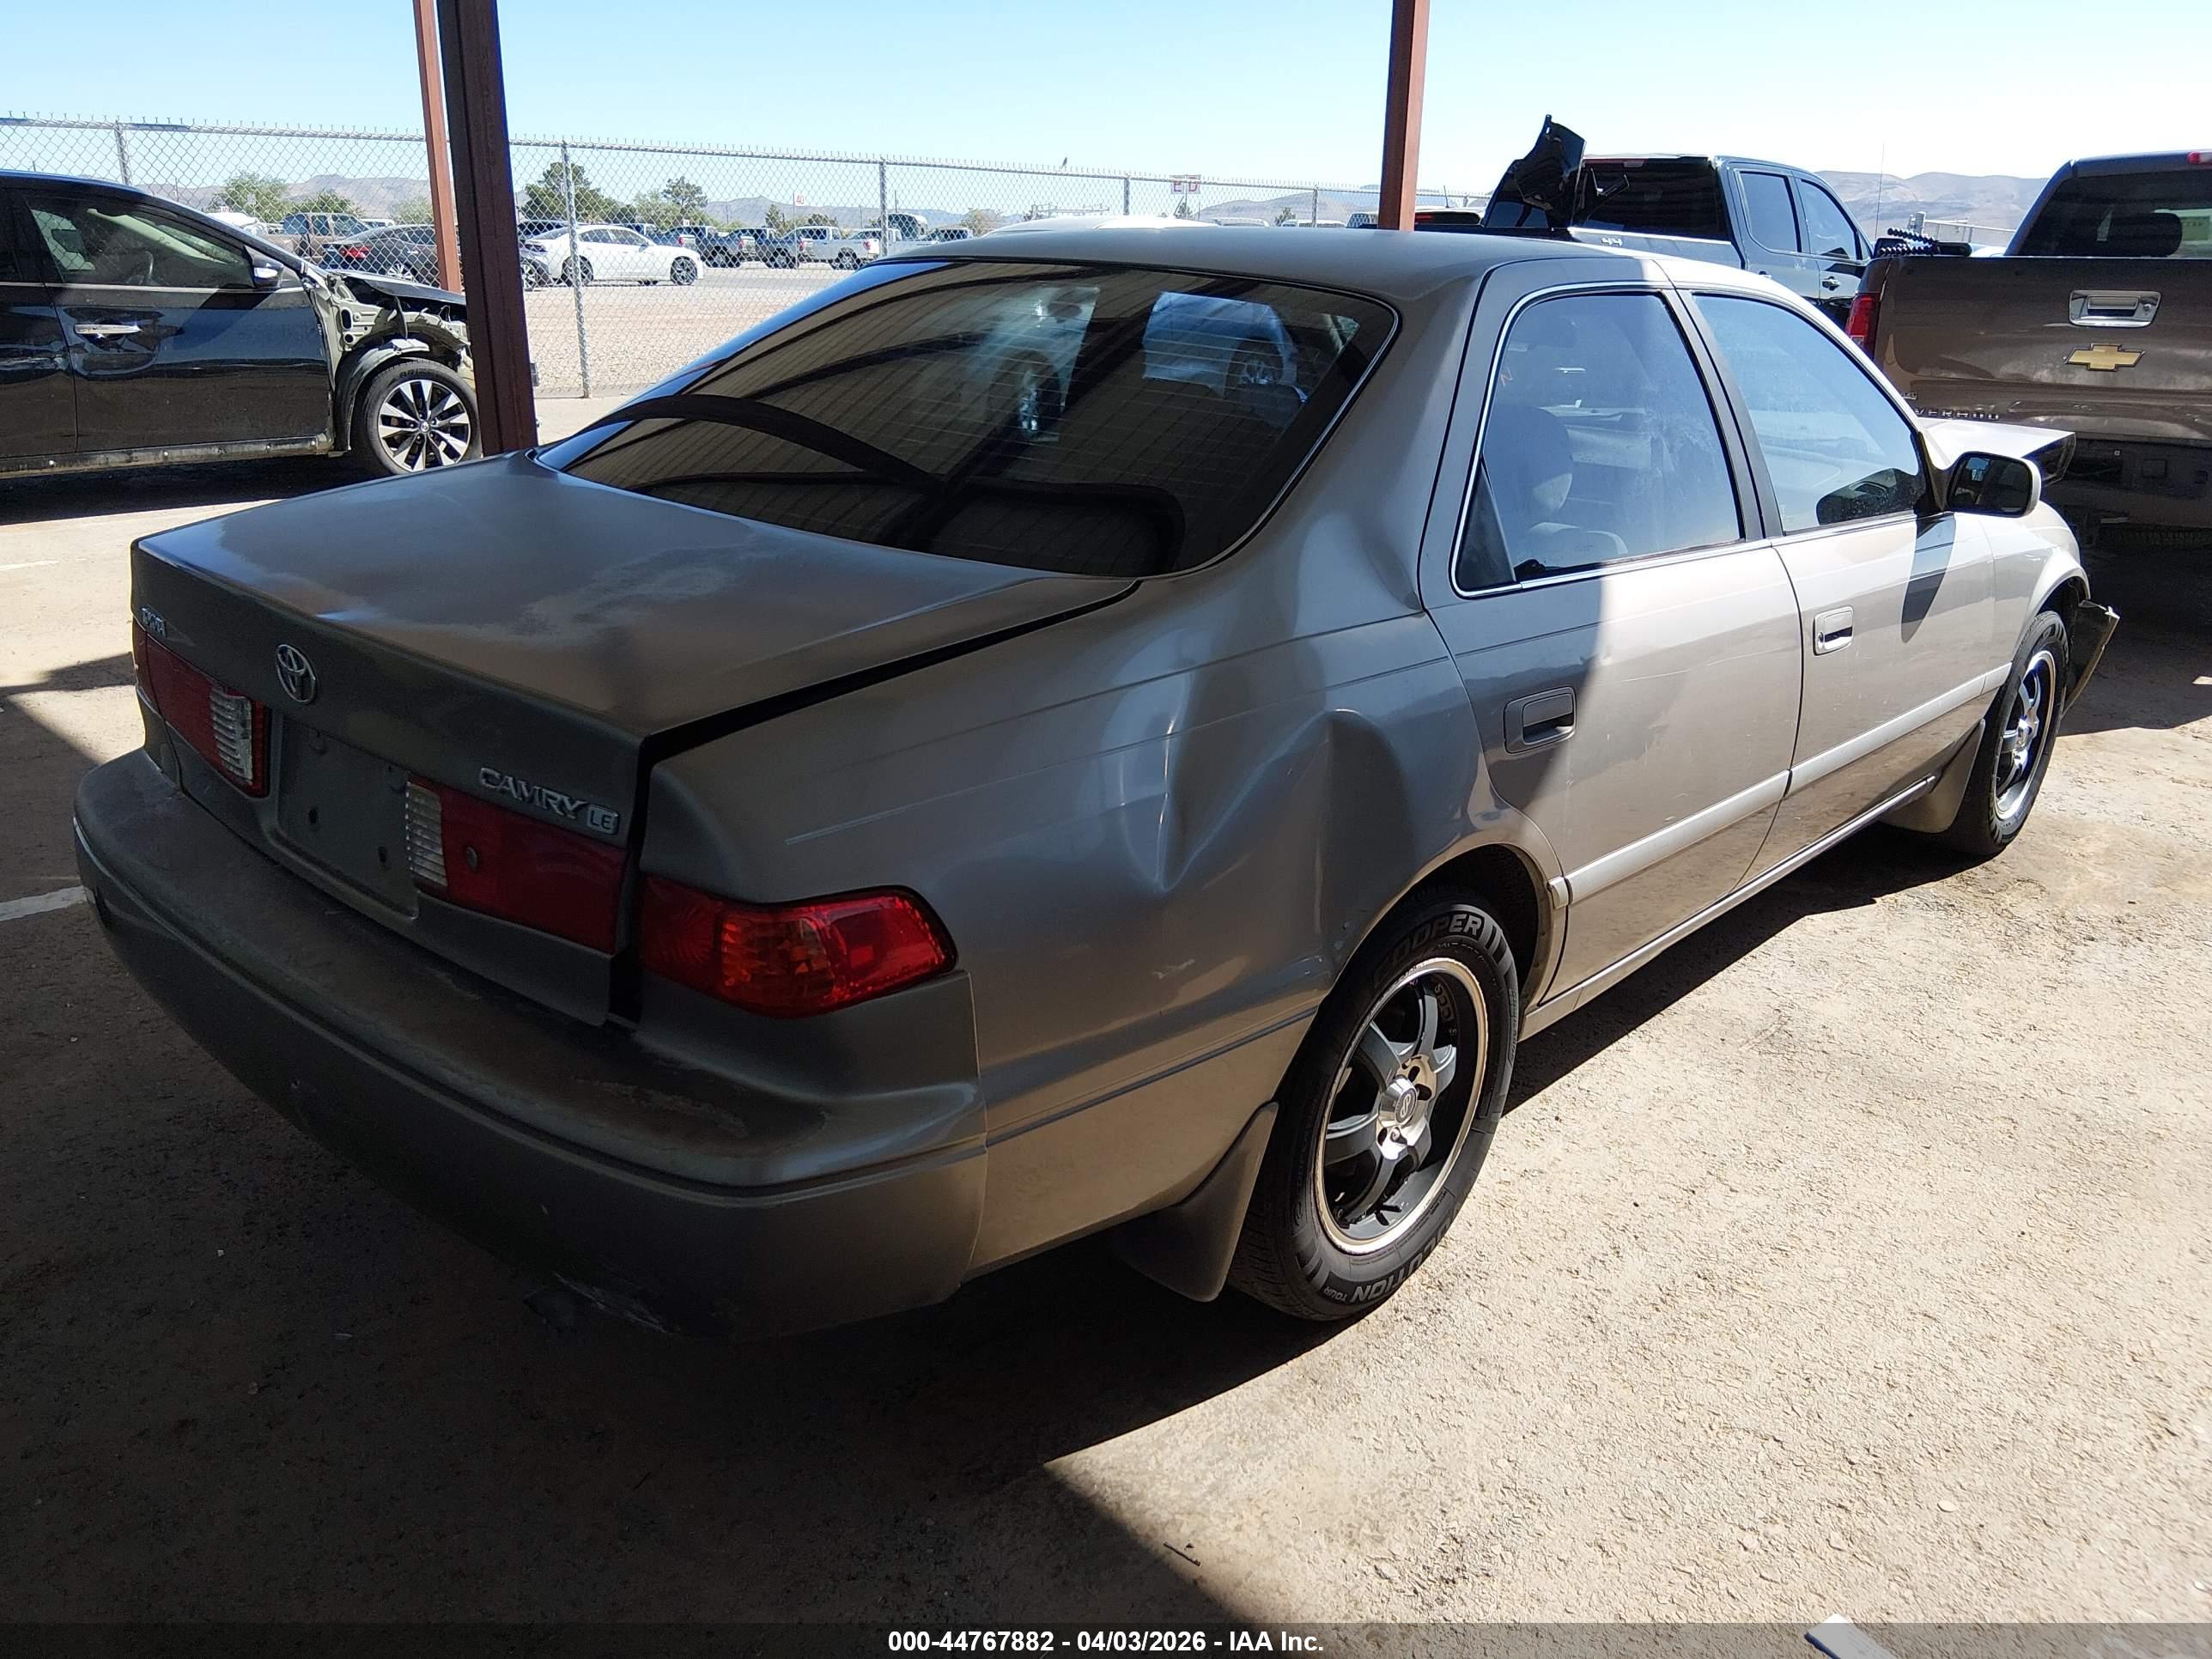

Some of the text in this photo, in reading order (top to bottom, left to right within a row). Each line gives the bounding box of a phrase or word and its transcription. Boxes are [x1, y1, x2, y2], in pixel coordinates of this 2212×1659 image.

[479, 766, 616, 832] CAMRY LE
[1323, 1286, 1349, 1302] TOUR
